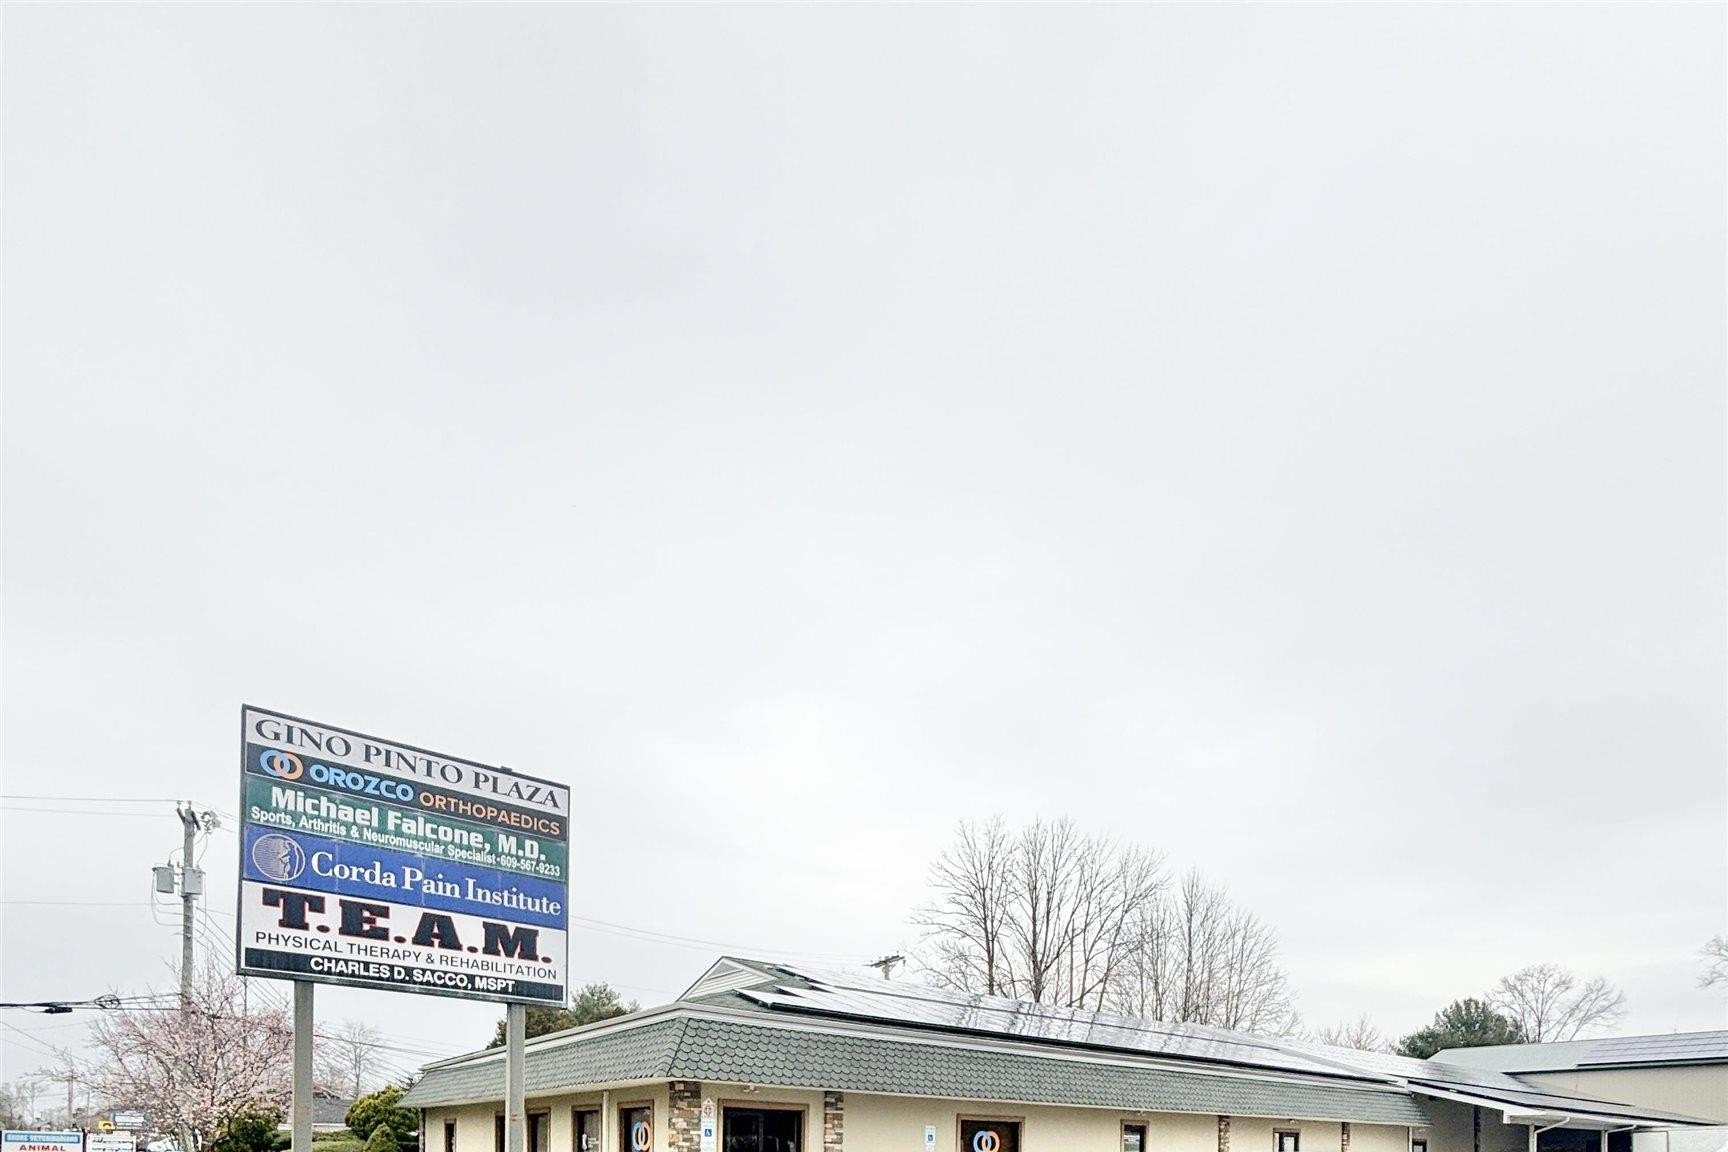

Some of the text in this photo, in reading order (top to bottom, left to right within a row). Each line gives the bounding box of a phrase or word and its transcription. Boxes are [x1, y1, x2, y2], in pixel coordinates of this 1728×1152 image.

[255, 719, 561, 809] GINO PINTO PLAZA
[251, 806, 295, 828] Sports,
[299, 816, 347, 836] Arthritis
[350, 827, 360, 838] &
[363, 827, 445, 854] Neuromuscular
[271, 786, 546, 861] Michael Falcone, M.D.
[309, 764, 560, 836] OROZCO ORTHOPAEDICS
[311, 851, 562, 916] Corda Pain Institute
[255, 931, 557, 980] PHYSICAL THERAPY & REHABILITATION
[262, 887, 553, 964] T.E.A.M.
[310, 957, 516, 992] CHARLES D. SACCO, MSPT
[19, 1144, 67, 1152] ANIMAL
